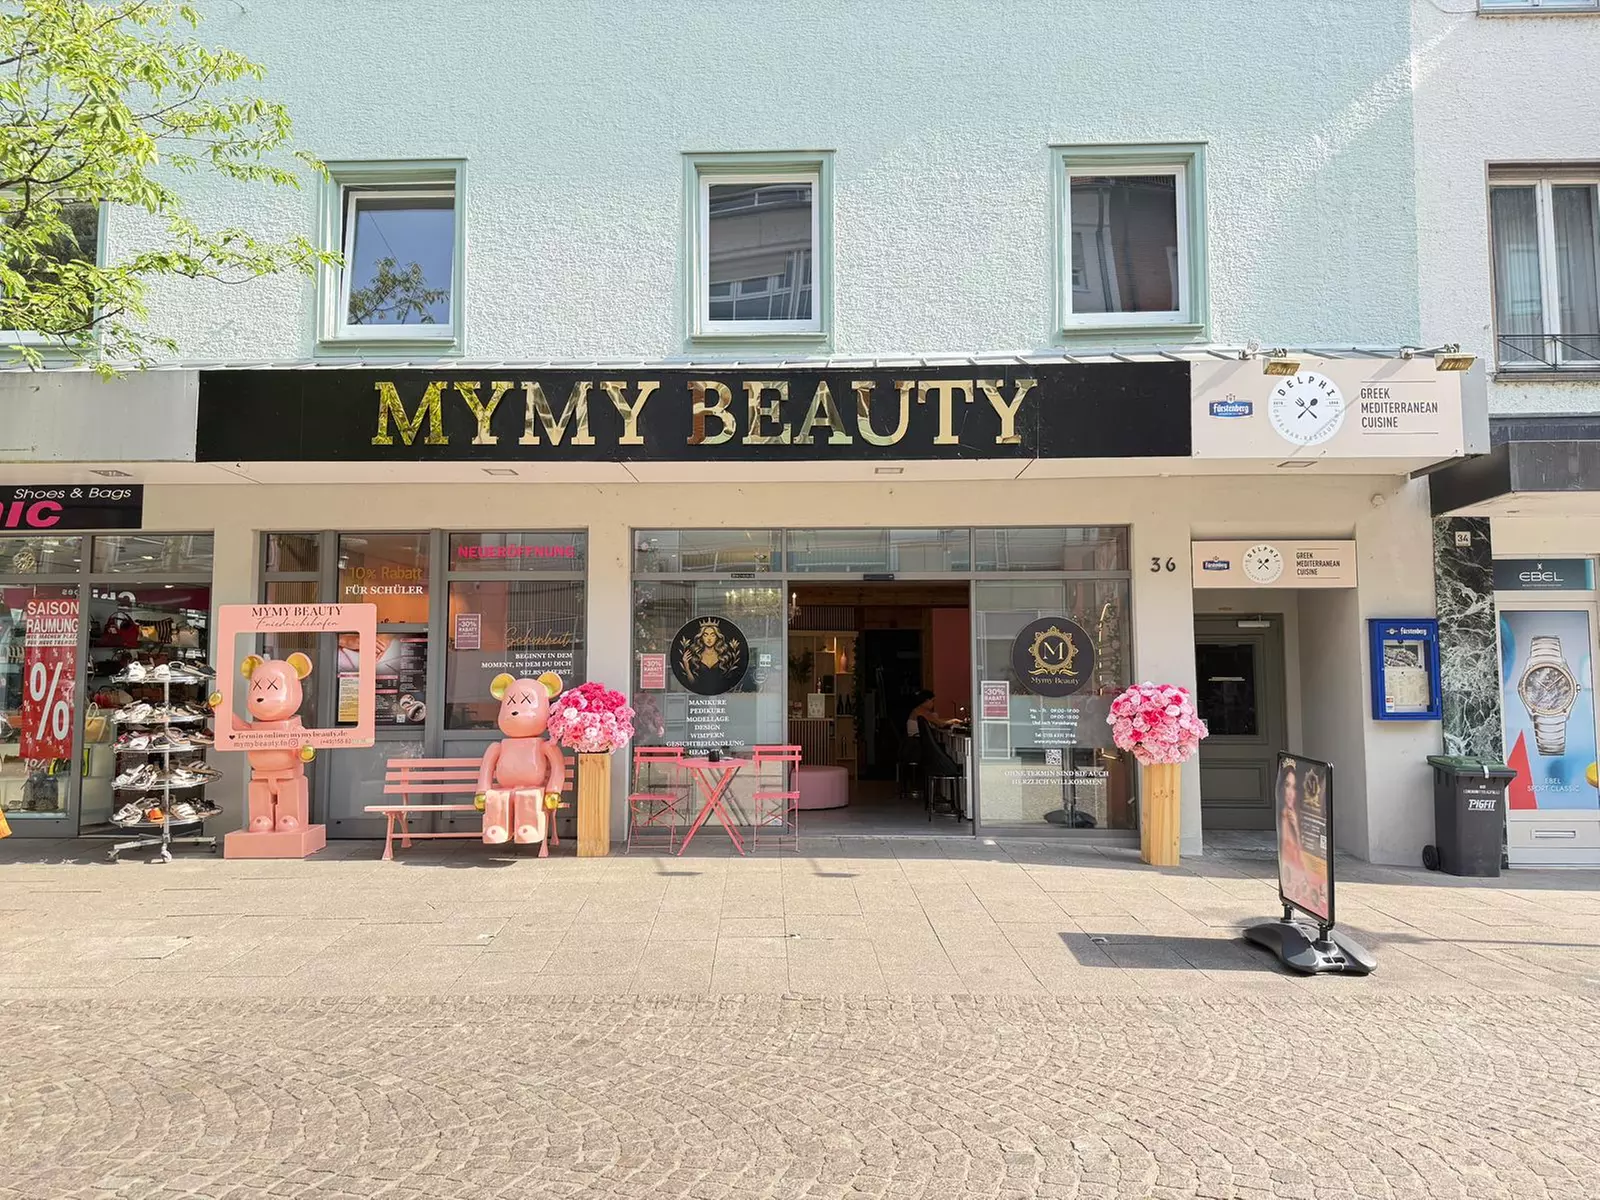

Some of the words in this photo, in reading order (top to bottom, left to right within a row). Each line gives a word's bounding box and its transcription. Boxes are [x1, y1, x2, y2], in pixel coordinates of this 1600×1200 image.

[1277, 376, 1336, 397] DELPHI
[1360, 387, 1390, 400] GREEK
[371, 381, 660, 446] MYMY
[687, 379, 1038, 446] BEAUTY
[1360, 401, 1438, 414] MEDITERRANEAN
[1361, 416, 1399, 429] CUISINE
[13, 488, 66, 499] Shoes
[69, 487, 84, 499] &
[88, 488, 132, 501] Bags
[0, 500, 64, 528] IC
[1457, 534, 1469, 543] 34
[457, 543, 576, 559] NEUERÖFFNUNG
[1295, 551, 1314, 560] GREEK
[1150, 556, 1177, 573] 36
[1296, 560, 1341, 568] MEDITERRANEAN
[349, 567, 377, 580] 10%
[381, 566, 424, 580] Rabatt
[1296, 568, 1319, 576] CUISINE
[1519, 571, 1565, 582] EBEL
[345, 584, 368, 595] FÜR
[370, 584, 424, 595] SCHÜLER
[27, 601, 80, 616] SAISON
[252, 606, 294, 617] MYMY
[294, 605, 343, 617] BEAUTY
[26, 615, 80, 633] RÄUMUNG
[515, 652, 546, 660] BEGINNT
[1043, 641, 1064, 660] M
[480, 660, 515, 669] MOMENT,
[516, 660, 524, 668] IN
[525, 660, 541, 668] DEM
[554, 659, 572, 667] DICH
[1030, 676, 1052, 685] Mymy
[1055, 677, 1080, 686] Beauty
[236, 731, 264, 740] Termin
[1544, 777, 1562, 785] EBEL
[1526, 784, 1549, 793] SPORT
[1550, 784, 1581, 793] CLASSIC
